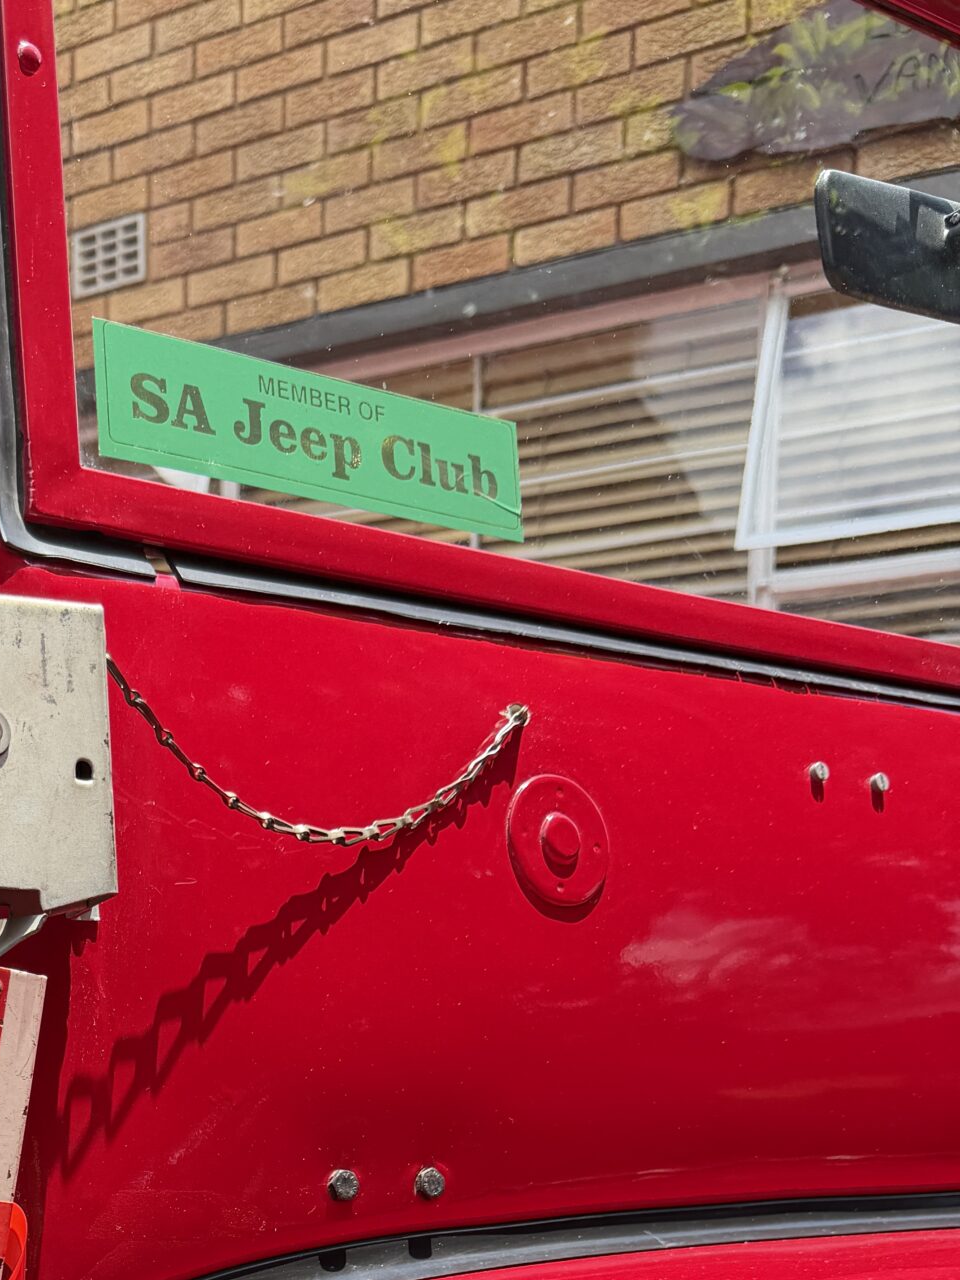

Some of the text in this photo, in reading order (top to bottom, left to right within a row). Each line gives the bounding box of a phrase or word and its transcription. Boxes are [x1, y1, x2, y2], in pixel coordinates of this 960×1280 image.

[130, 372, 498, 500] SA Jeep Club
[258, 374, 386, 422] MEMBER OF
